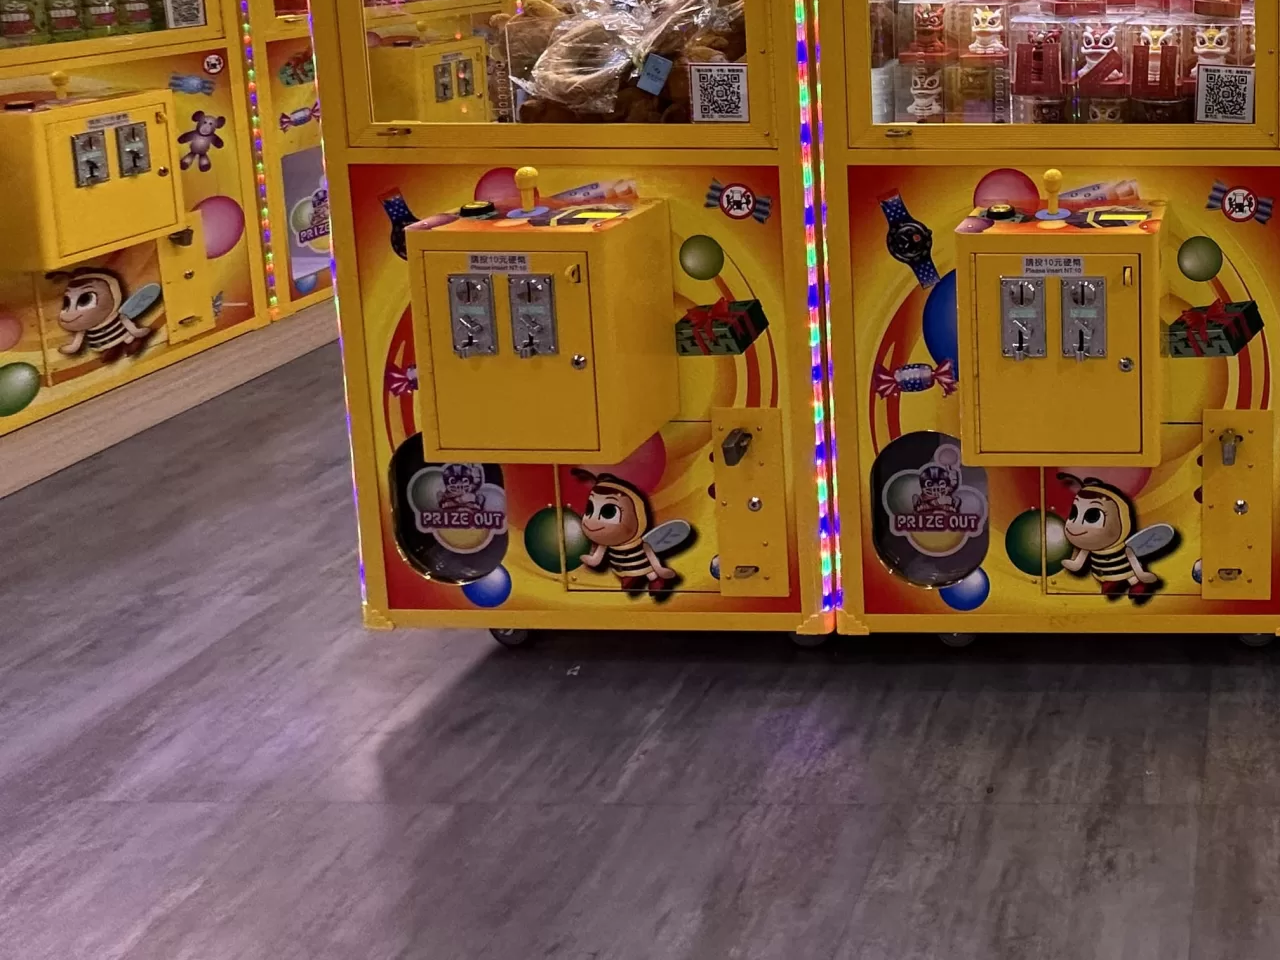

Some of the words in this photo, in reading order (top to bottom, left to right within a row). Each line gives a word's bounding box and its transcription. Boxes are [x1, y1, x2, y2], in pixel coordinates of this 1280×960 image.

[422, 512, 469, 526] PRIZE
[473, 513, 502, 527] OUT
[897, 515, 944, 529] PRIZE
[949, 515, 978, 529] OUT
